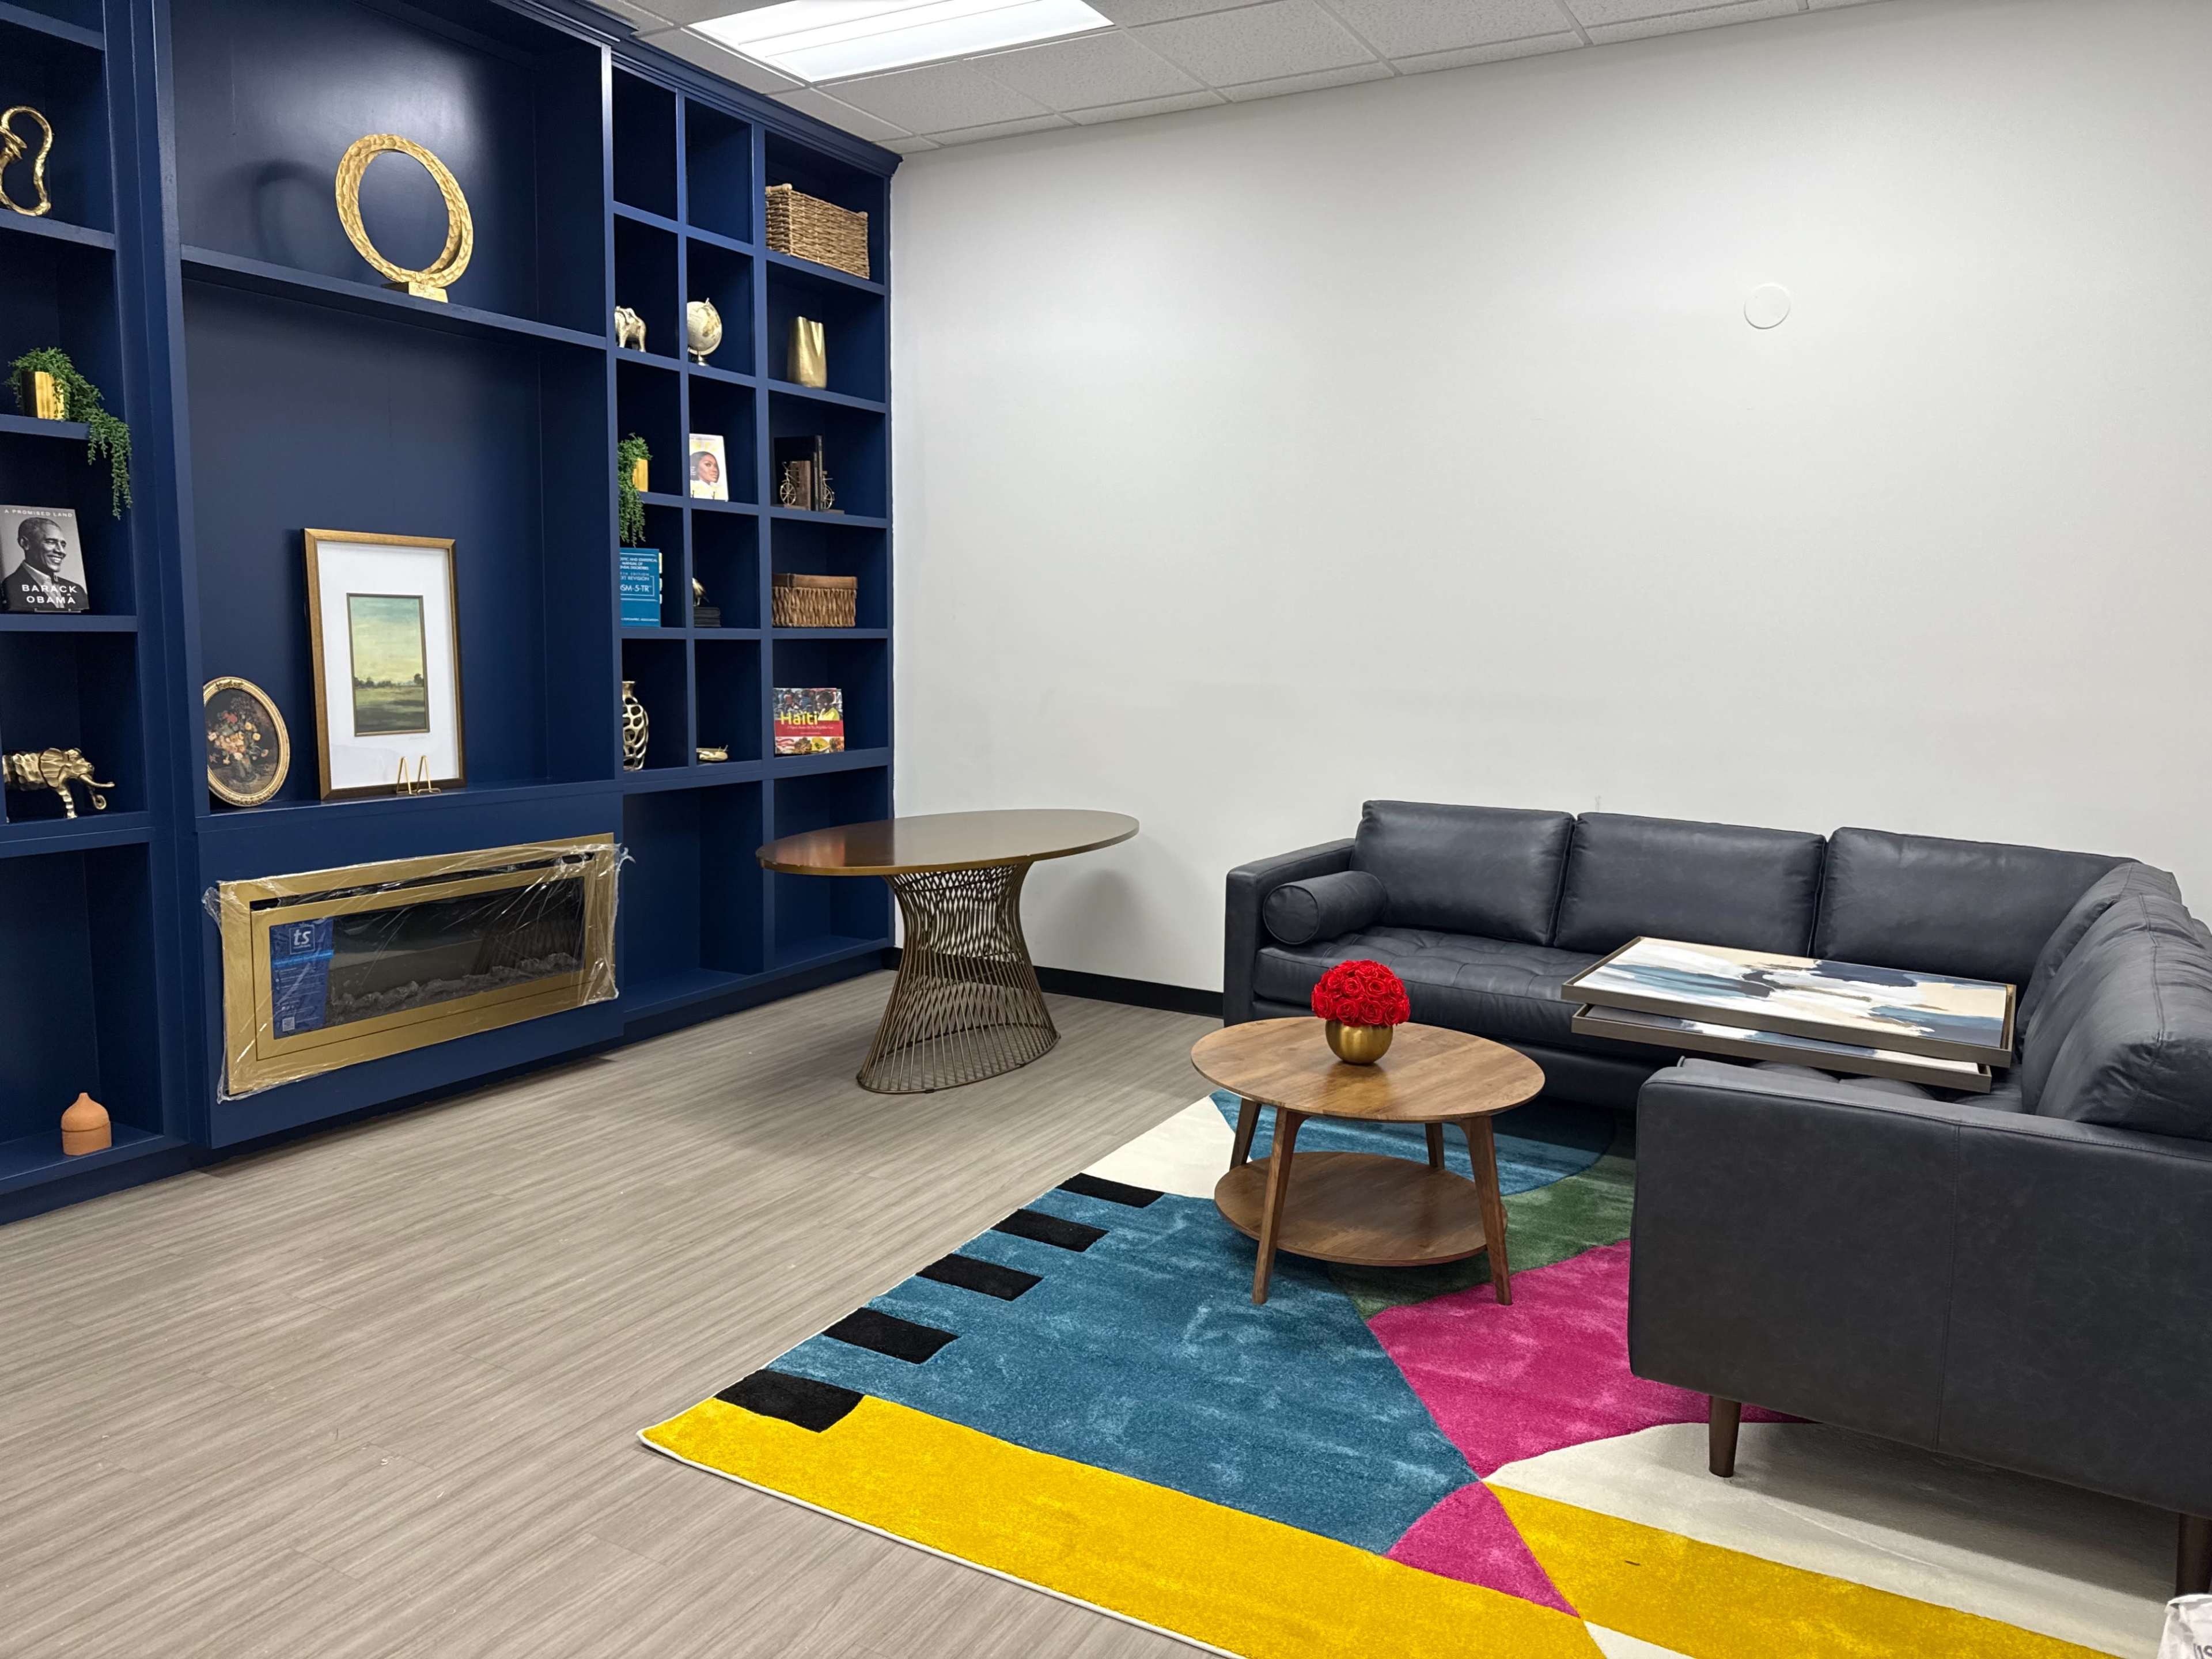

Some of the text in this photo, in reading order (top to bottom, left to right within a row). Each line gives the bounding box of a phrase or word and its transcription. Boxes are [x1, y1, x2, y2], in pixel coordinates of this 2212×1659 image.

[22, 584, 77, 593] BARACK
[26, 596, 76, 604] OBAMA
[294, 929, 312, 946] ts
